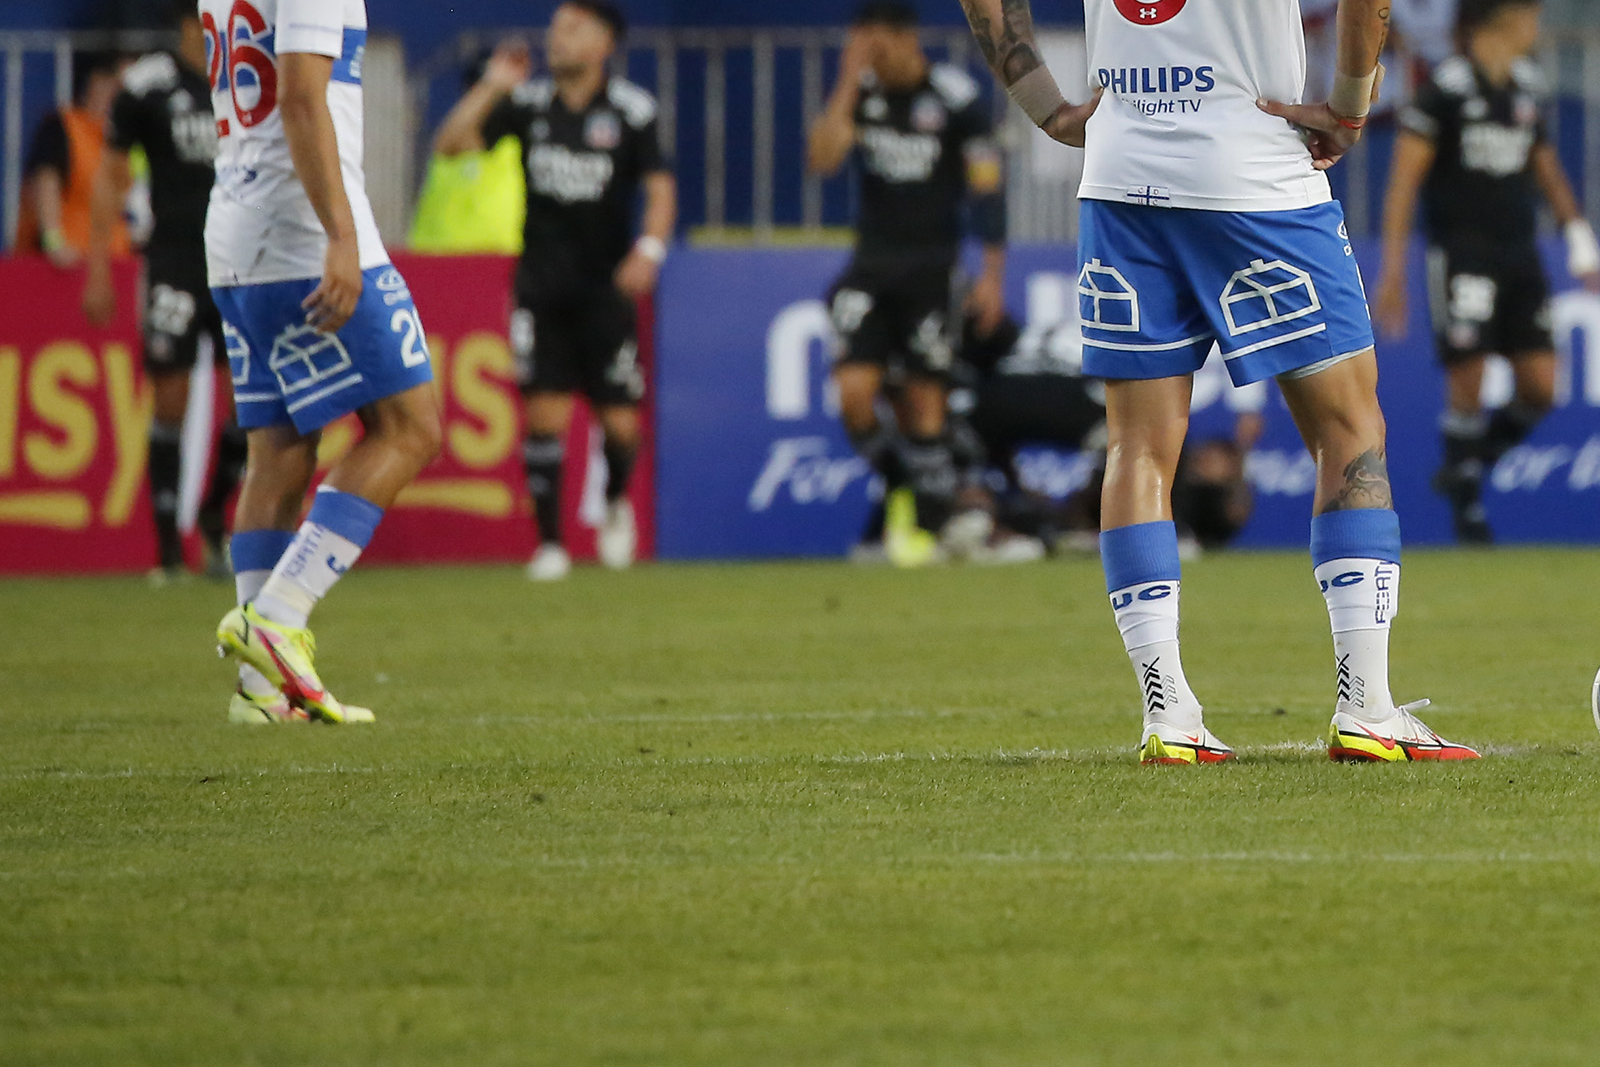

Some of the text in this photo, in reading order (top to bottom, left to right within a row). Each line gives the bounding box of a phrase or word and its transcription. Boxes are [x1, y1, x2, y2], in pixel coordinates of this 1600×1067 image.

[1097, 65, 1216, 94] PHILIPS
[1176, 98, 1202, 114] TV
[390, 307, 430, 369] 2
[1112, 584, 1172, 611] UC
